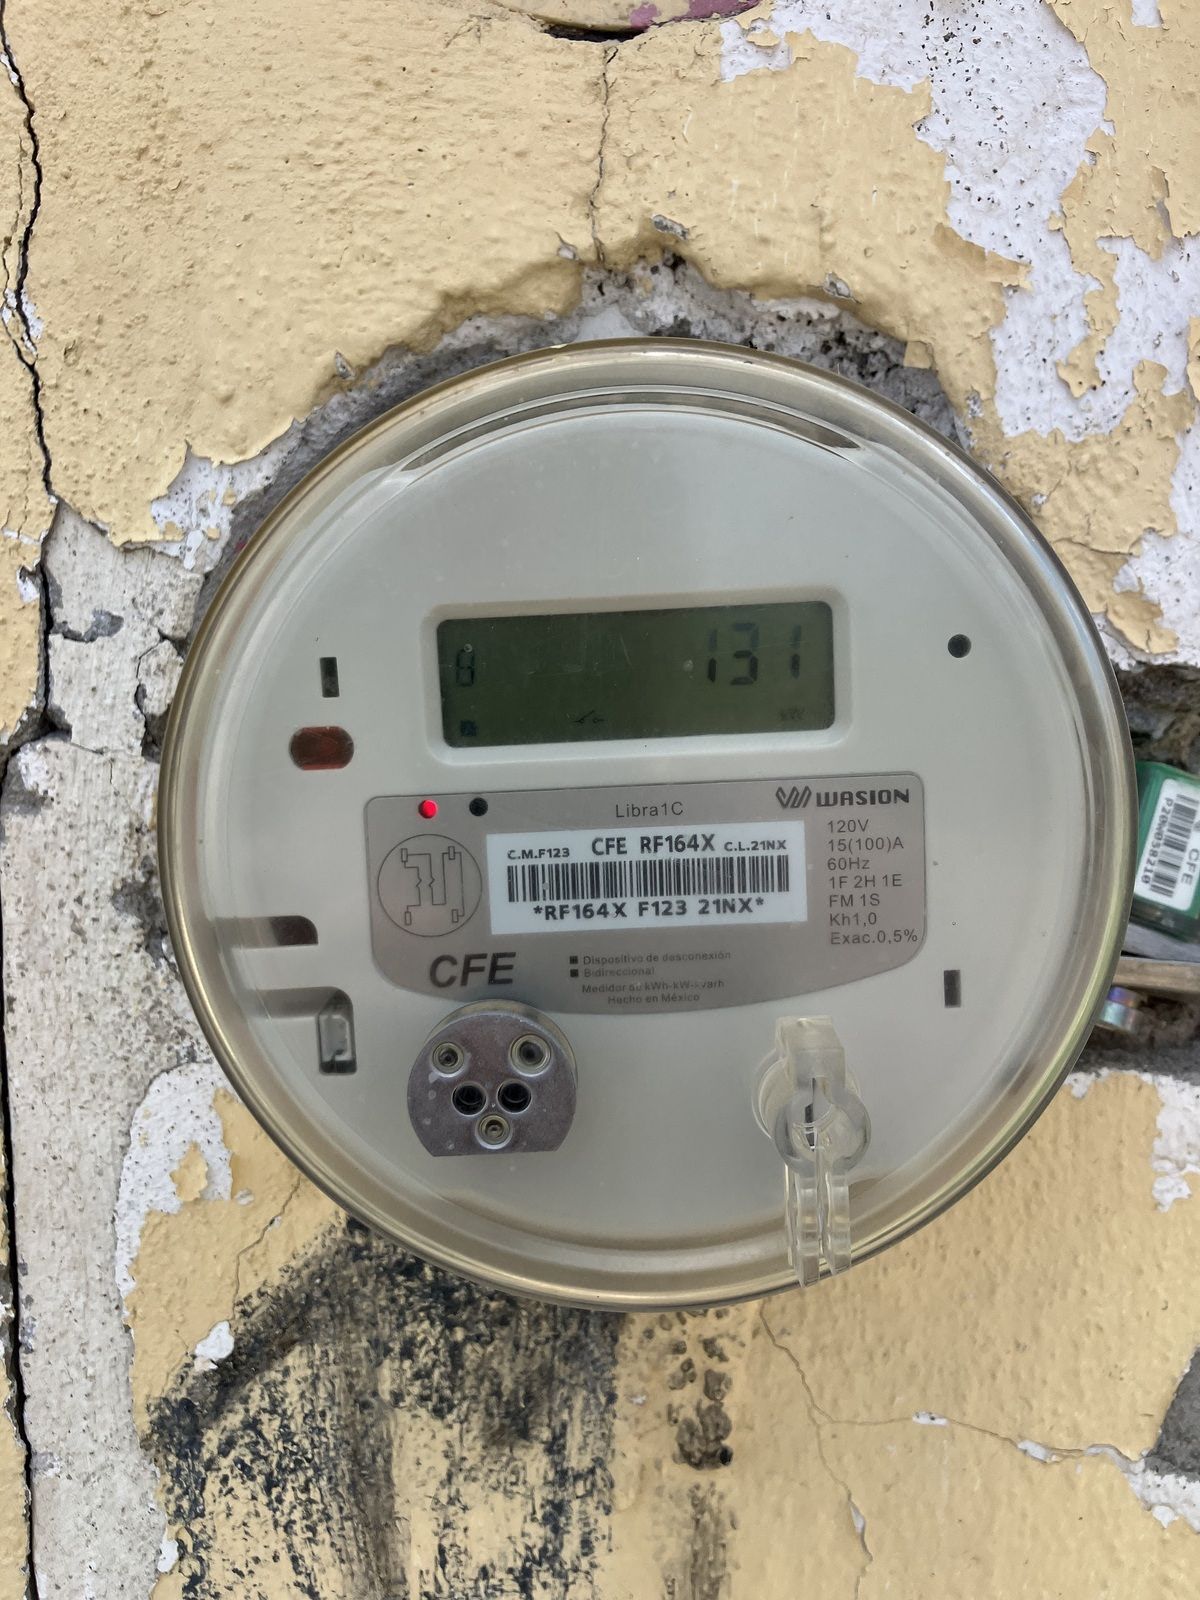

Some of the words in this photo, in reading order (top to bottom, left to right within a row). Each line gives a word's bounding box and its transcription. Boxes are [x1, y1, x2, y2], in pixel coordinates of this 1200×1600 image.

[707, 621, 802, 686] 131
[816, 788, 910, 808] WASION
[615, 801, 684, 818] Libra1C
[828, 818, 869, 833] 120V
[507, 847, 570, 861] C.M.F123
[591, 836, 627, 856] CFE
[640, 833, 716, 854] RF164X
[724, 839, 787, 852] C.L.21NX
[828, 837, 904, 855] 15(100)A
[828, 857, 870, 871] 60Hz
[1181, 848, 1200, 885] CFE
[829, 876, 849, 889] 1F
[853, 875, 876, 888] 2H
[882, 874, 902, 887] 1E
[638, 900, 688, 917] F123
[829, 894, 854, 908] FM
[861, 893, 880, 907] 1S
[830, 911, 877, 928] Kh1,0
[831, 929, 918, 945] Exac.0,5%
[429, 951, 517, 988] CFE
